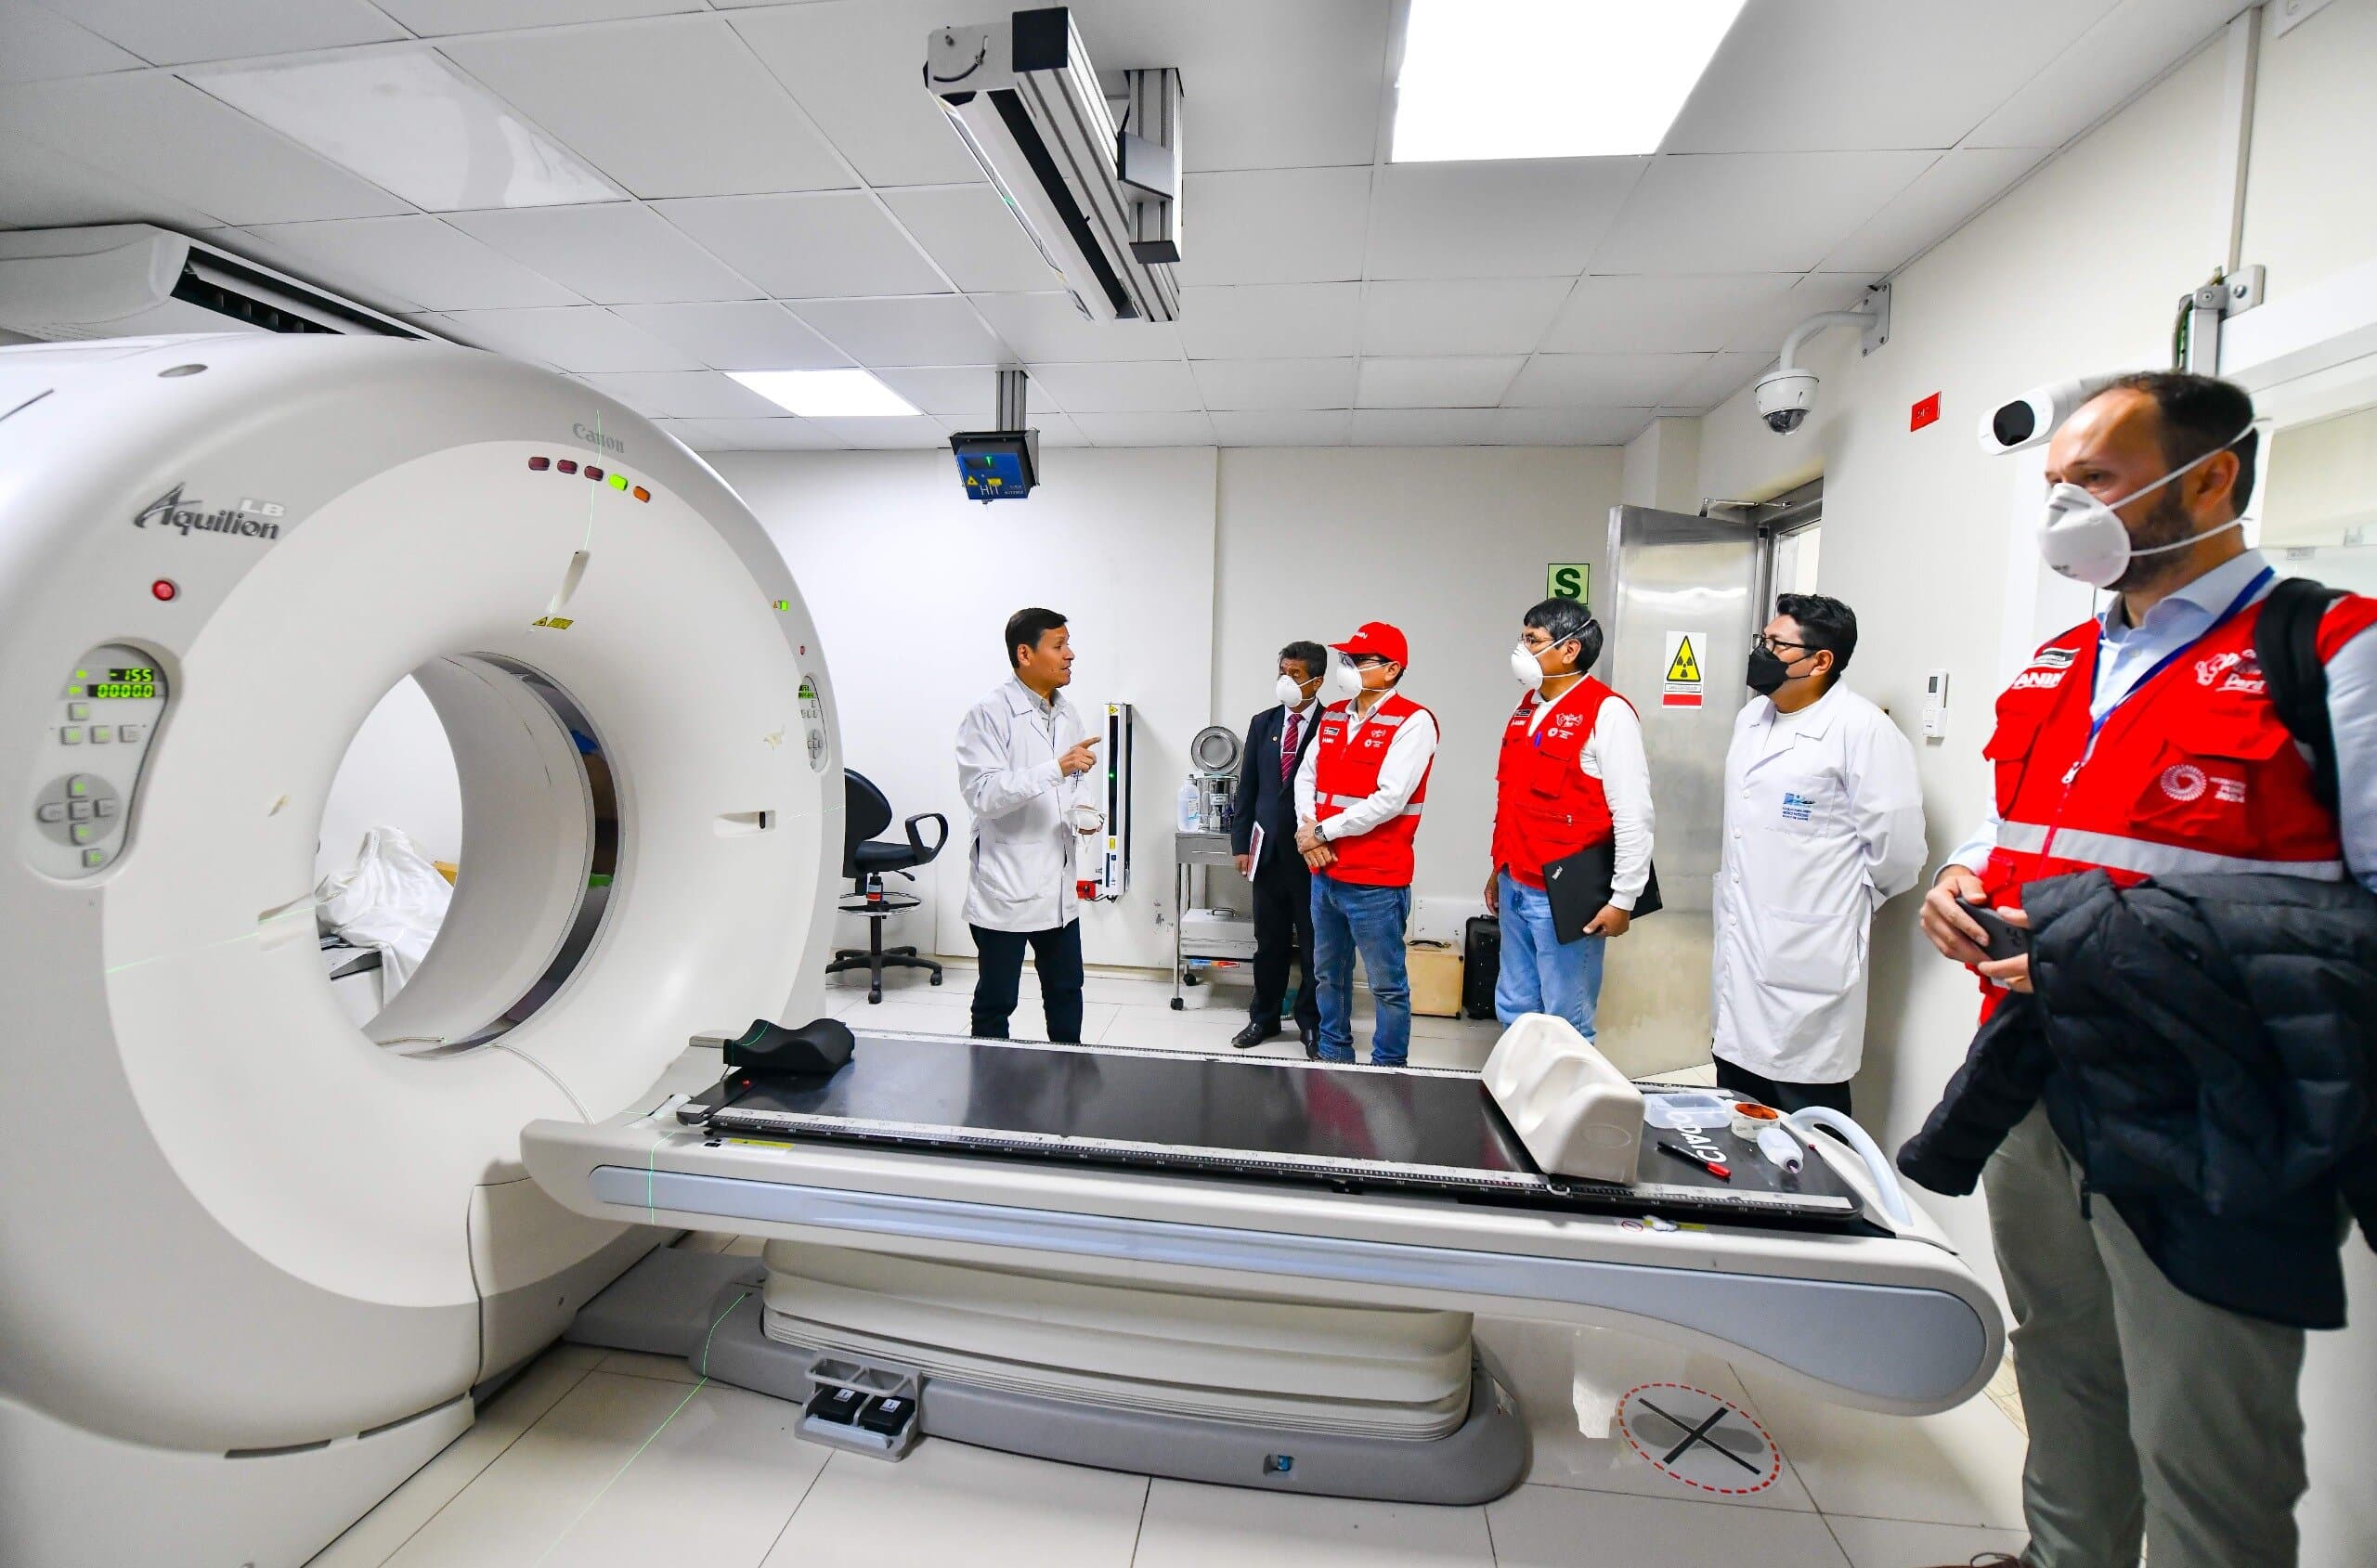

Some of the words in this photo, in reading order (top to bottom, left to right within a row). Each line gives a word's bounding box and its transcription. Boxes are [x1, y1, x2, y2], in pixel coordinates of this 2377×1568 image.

[572, 422, 625, 453] Canon
[134, 482, 279, 539] Aquilion
[240, 498, 284, 516] LB
[1554, 568, 1581, 599] S
